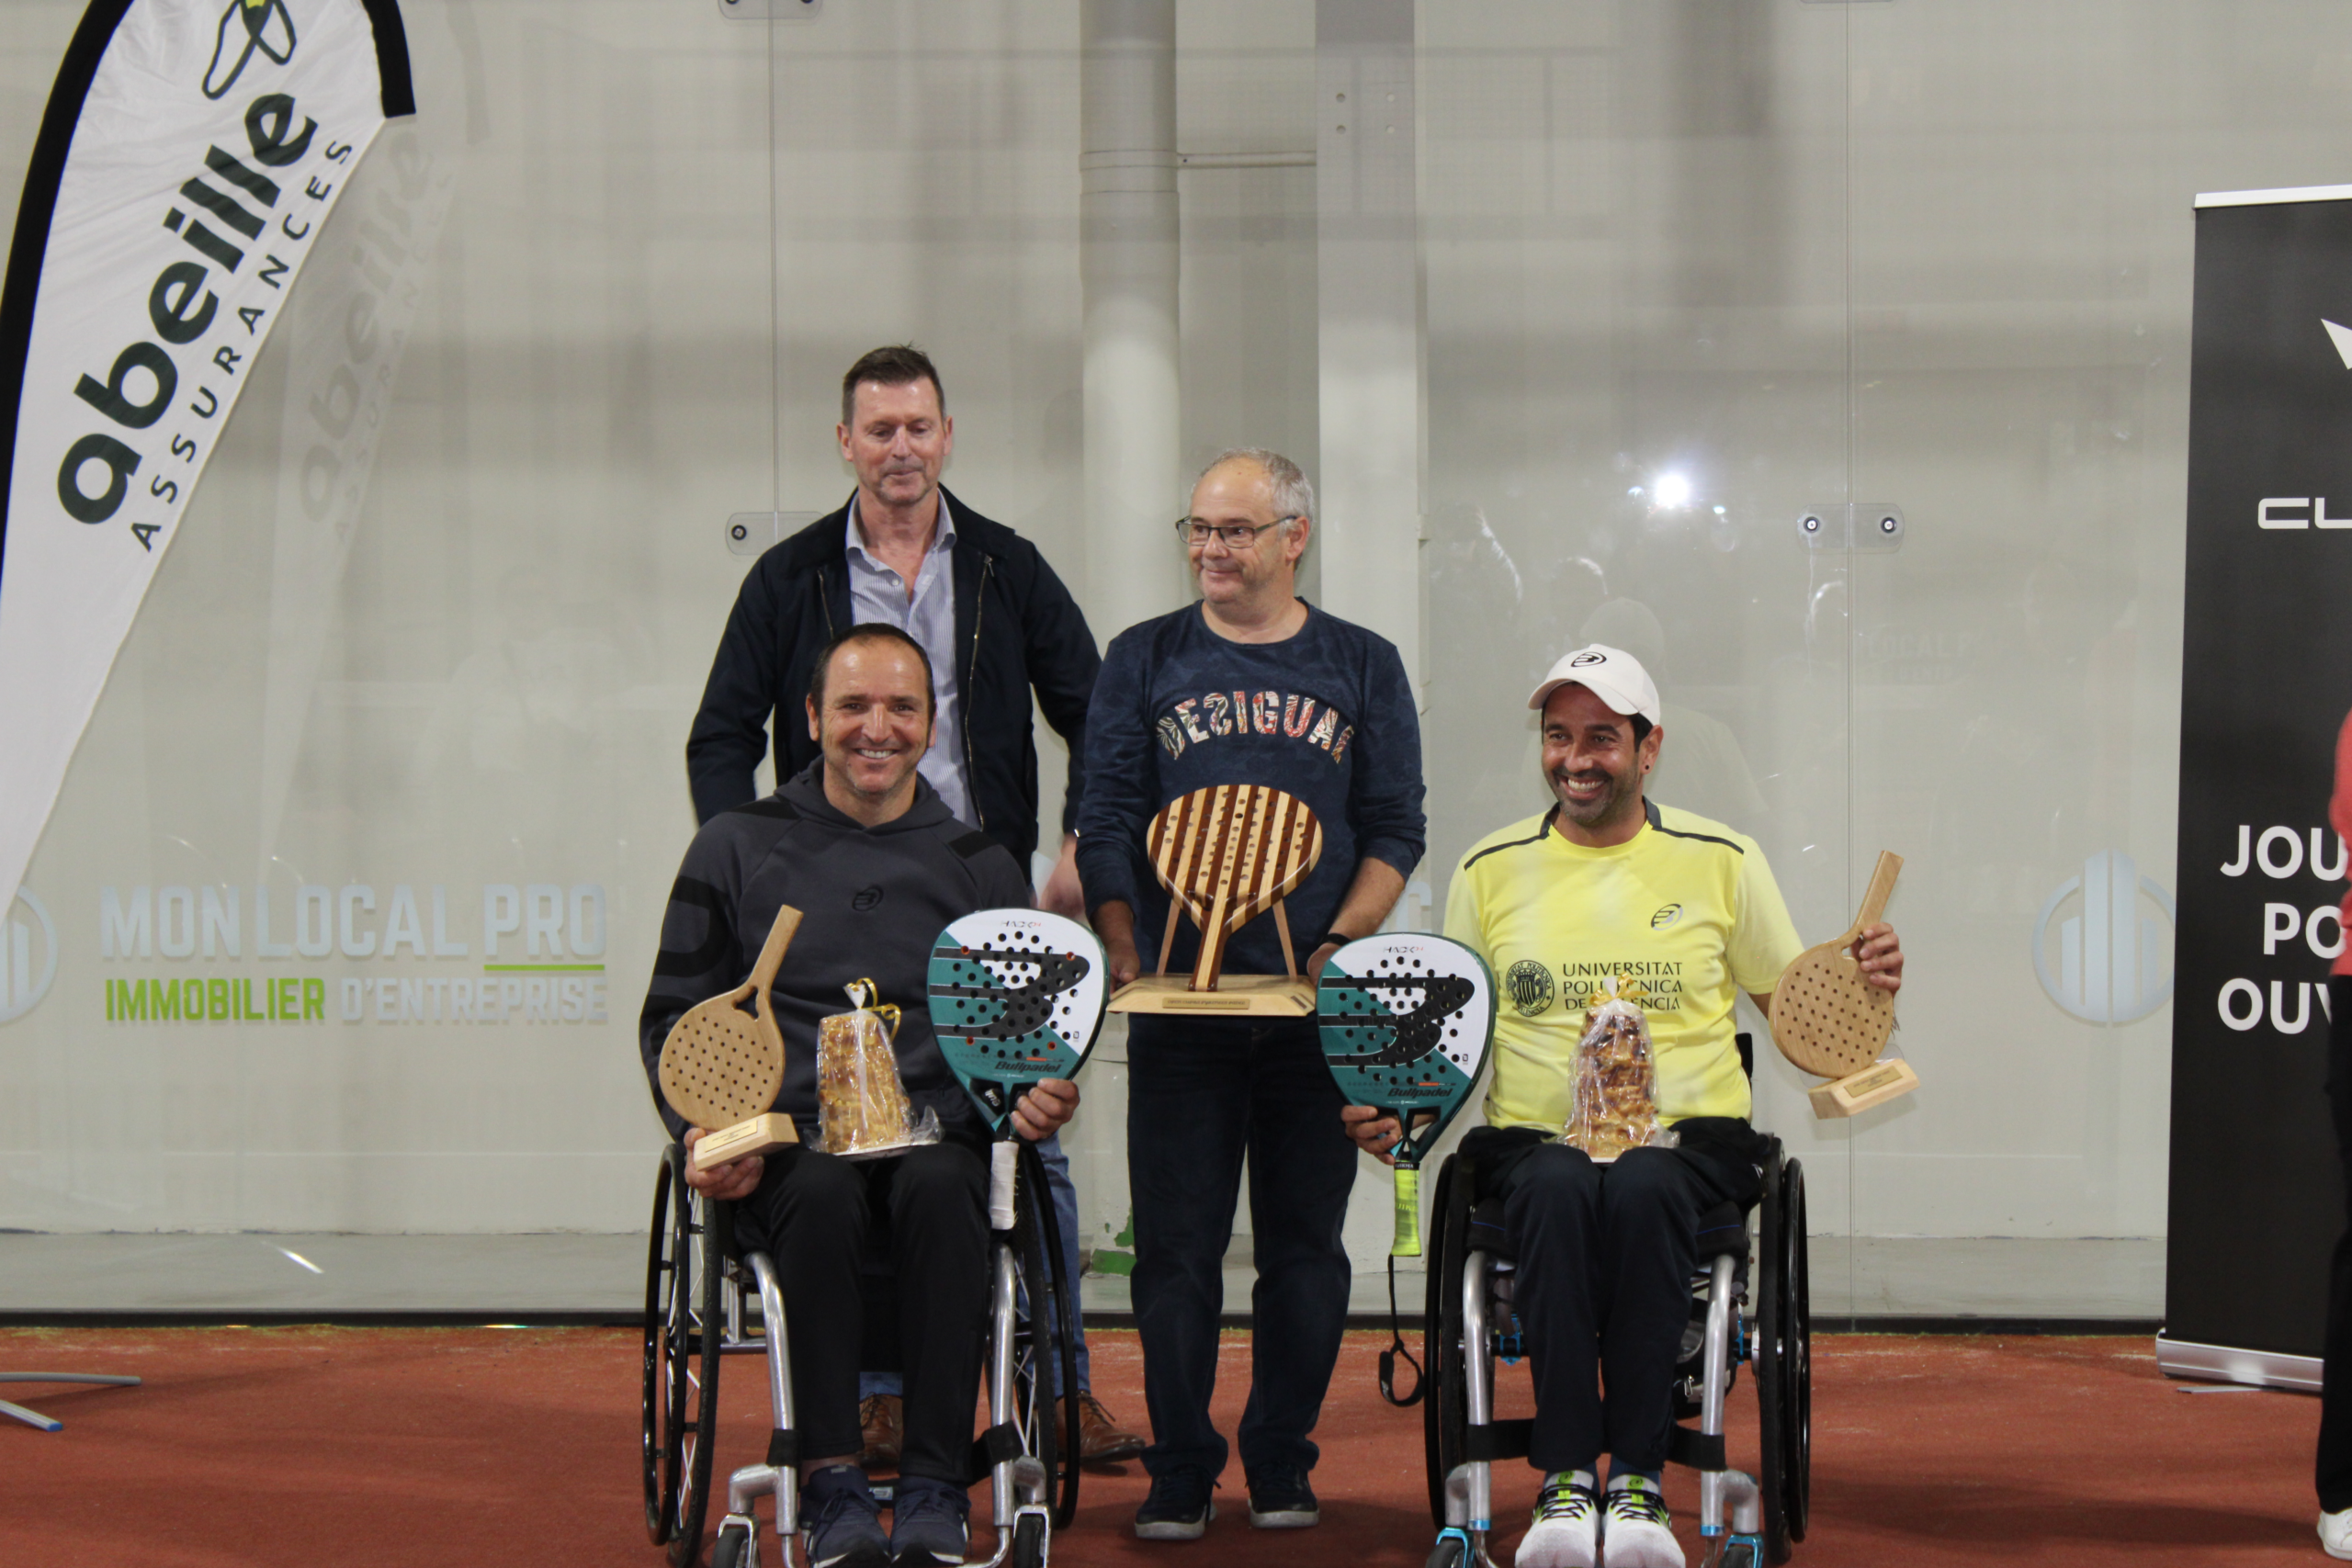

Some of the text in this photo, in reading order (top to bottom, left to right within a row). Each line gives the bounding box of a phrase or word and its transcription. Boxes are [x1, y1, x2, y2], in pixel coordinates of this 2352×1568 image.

[57, 93, 318, 525] abeille
[130, 141, 353, 552] ASSURANCES
[2220, 824, 2349, 882] JOU
[99, 884, 606, 958] MON LOCAL PRO
[2263, 902, 2347, 960] PO
[1562, 961, 1683, 977] UNIVERSITAT
[105, 976, 608, 1022] IMMOBILIER D'ENTREPRISE
[1565, 998, 1588, 1010] DE
[994, 1061, 1062, 1073] Bullpadel
[1386, 1088, 1453, 1100] Bullpadel
